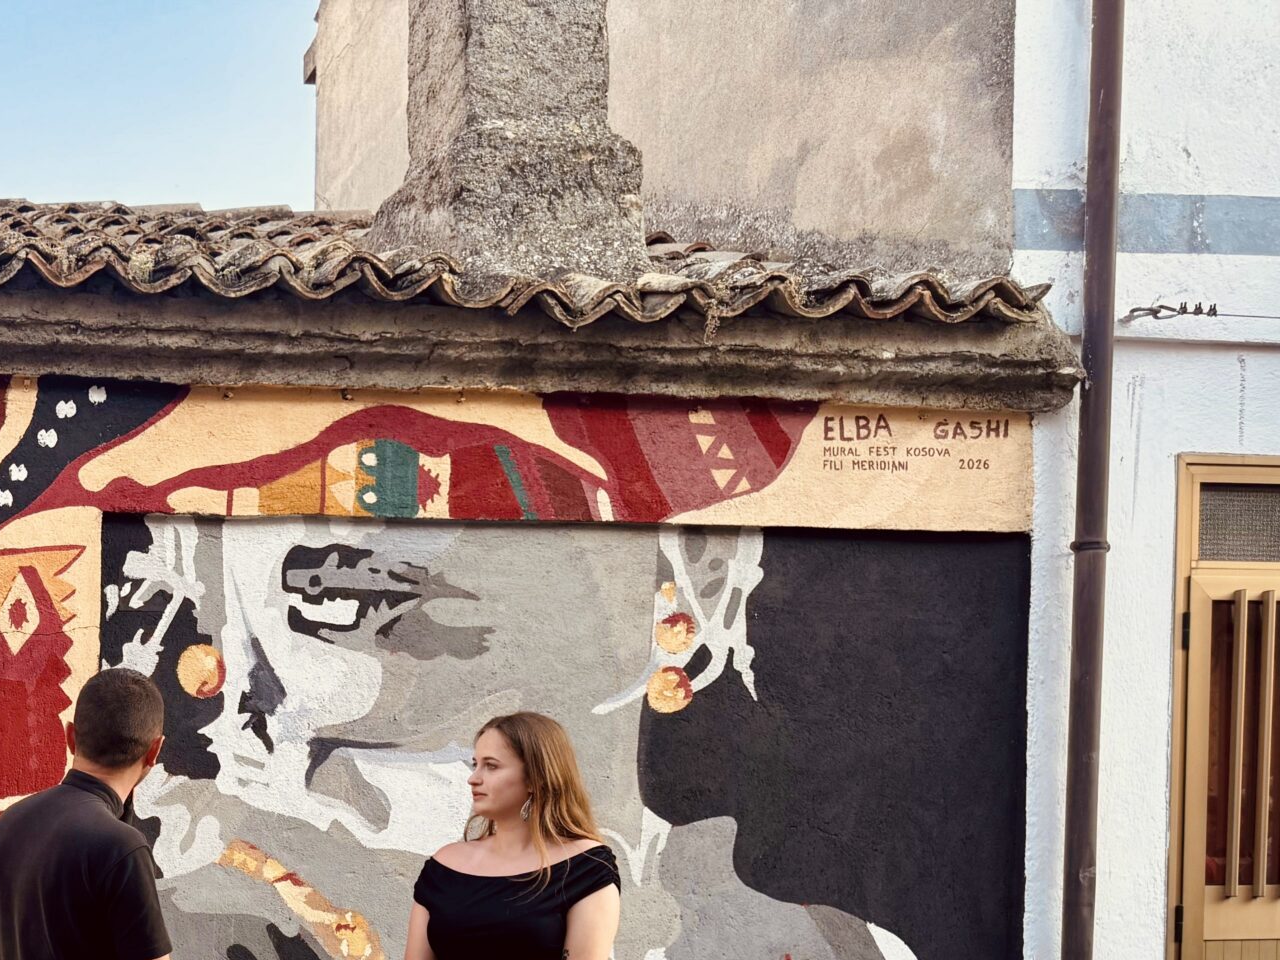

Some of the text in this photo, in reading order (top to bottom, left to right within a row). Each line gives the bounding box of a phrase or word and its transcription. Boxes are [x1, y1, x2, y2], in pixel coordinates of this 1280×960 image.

[823, 413, 1010, 441] ELBA GASHI
[823, 446, 951, 458] MURAL FEST KOSOVA
[823, 459, 990, 473] FILI MERIDIANI 2026
